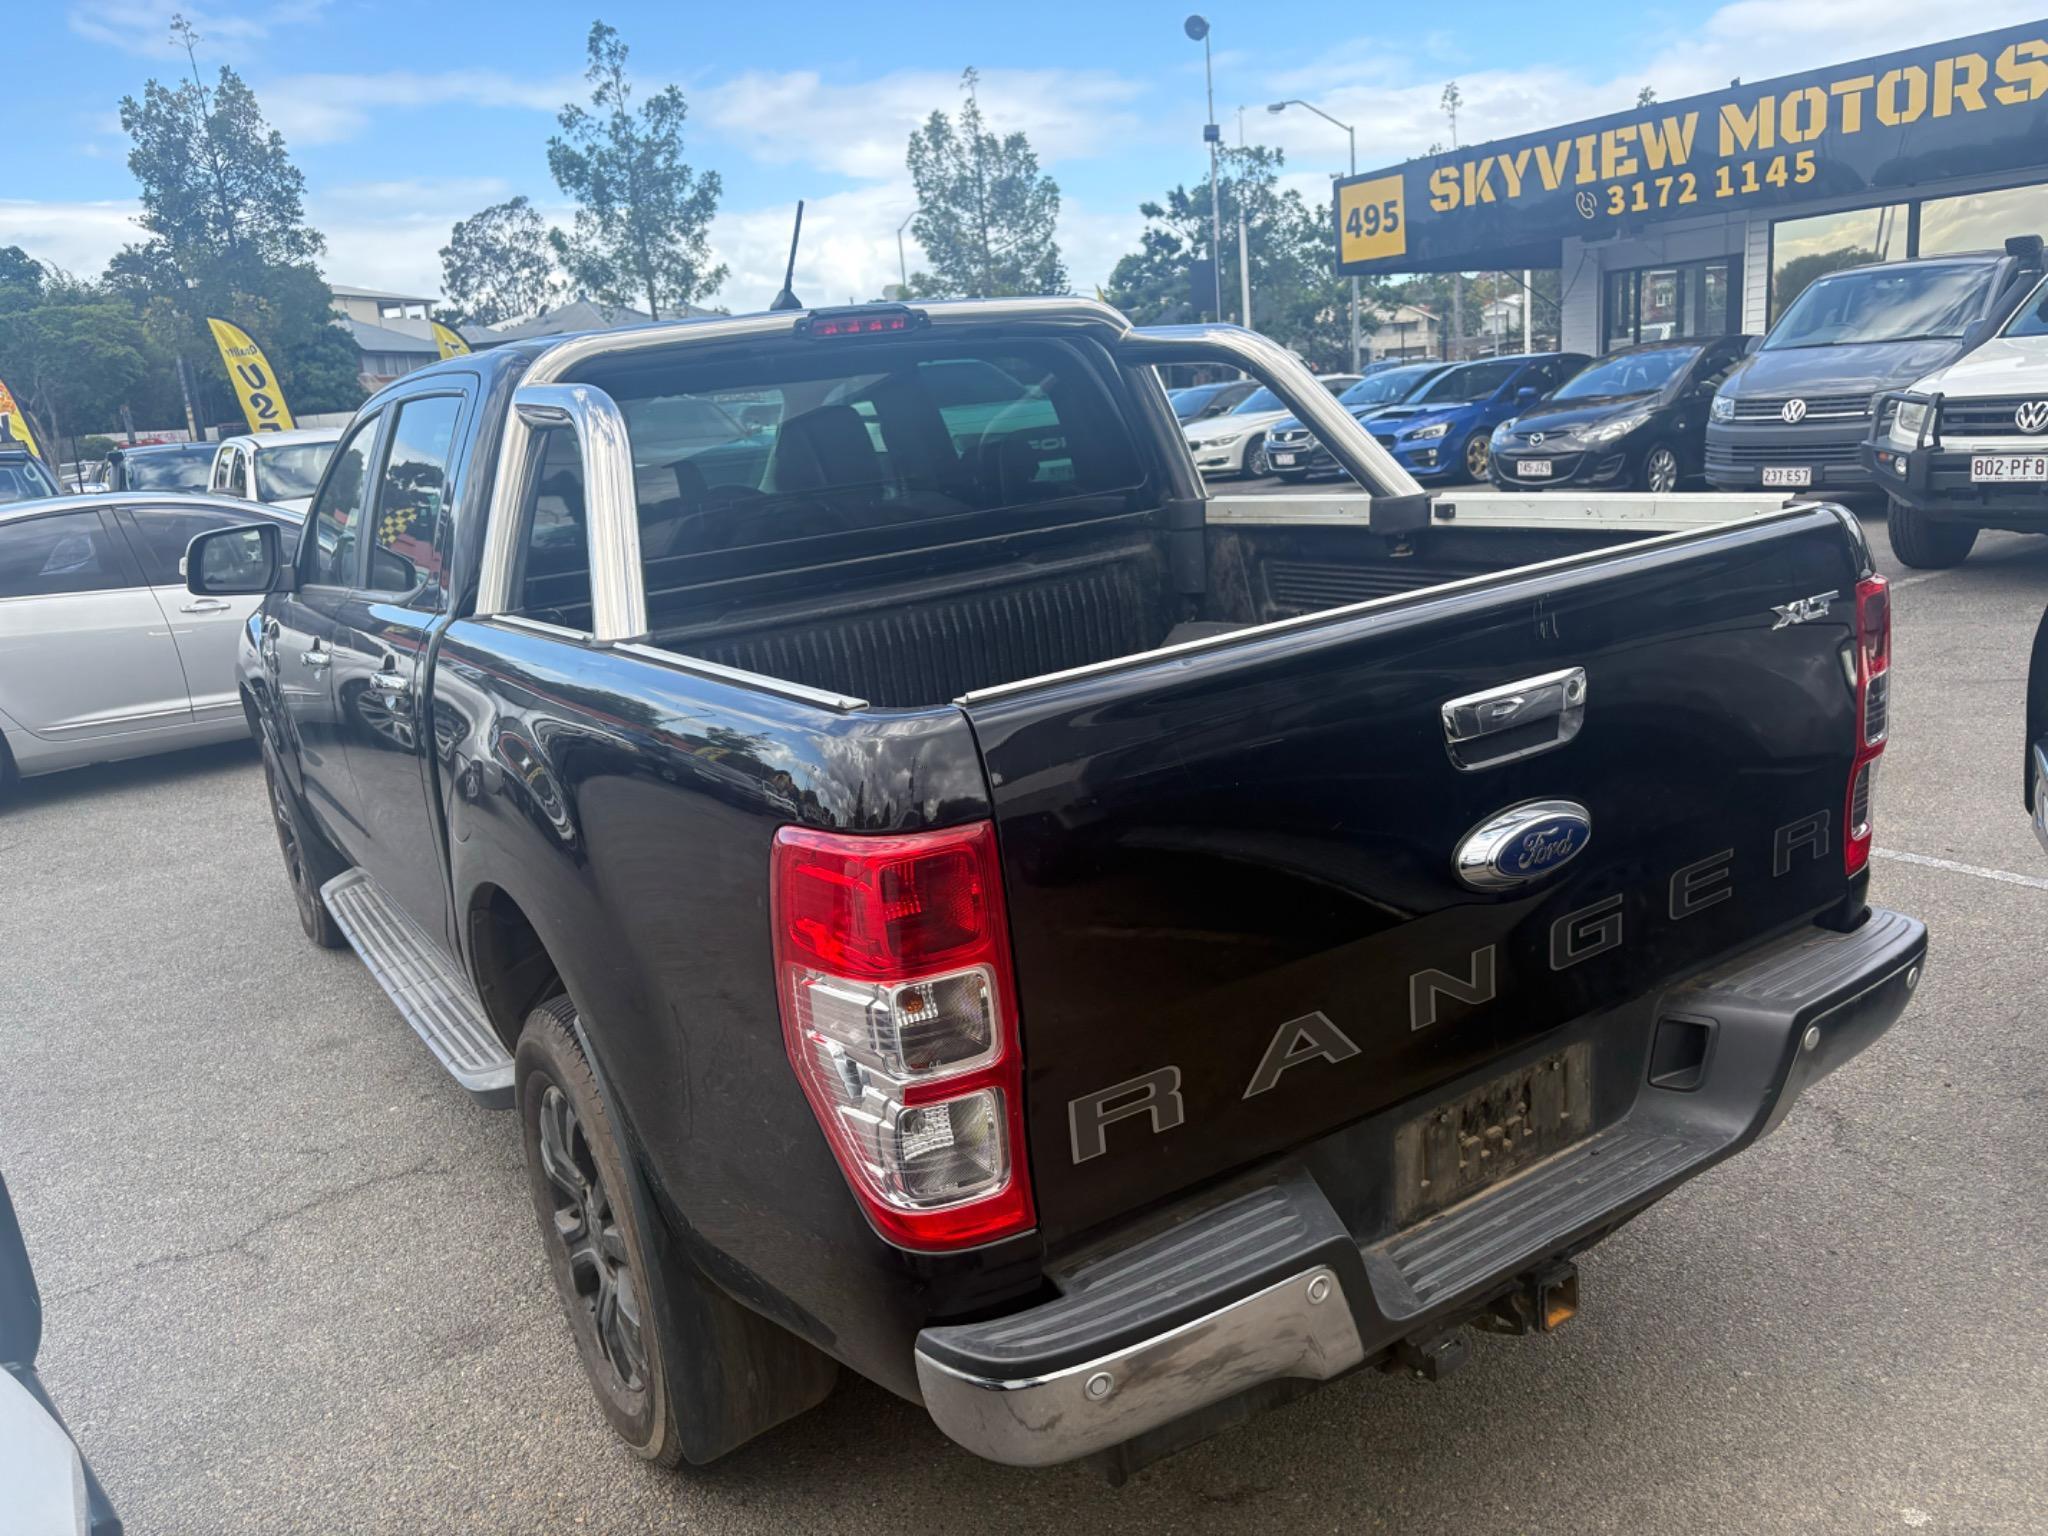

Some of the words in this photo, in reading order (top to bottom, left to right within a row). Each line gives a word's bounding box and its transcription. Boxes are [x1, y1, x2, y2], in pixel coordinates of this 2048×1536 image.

[1429, 112, 1699, 212] SKYVIEW
[1719, 39, 2048, 157] MOTORS
[1607, 172, 1698, 215] 3172
[1716, 150, 1816, 198] 1145
[1346, 200, 1399, 238] 495
[1769, 590, 1840, 630] XLT
[1518, 826, 1574, 870] Ford
[1069, 808, 1832, 1164] RANGER
